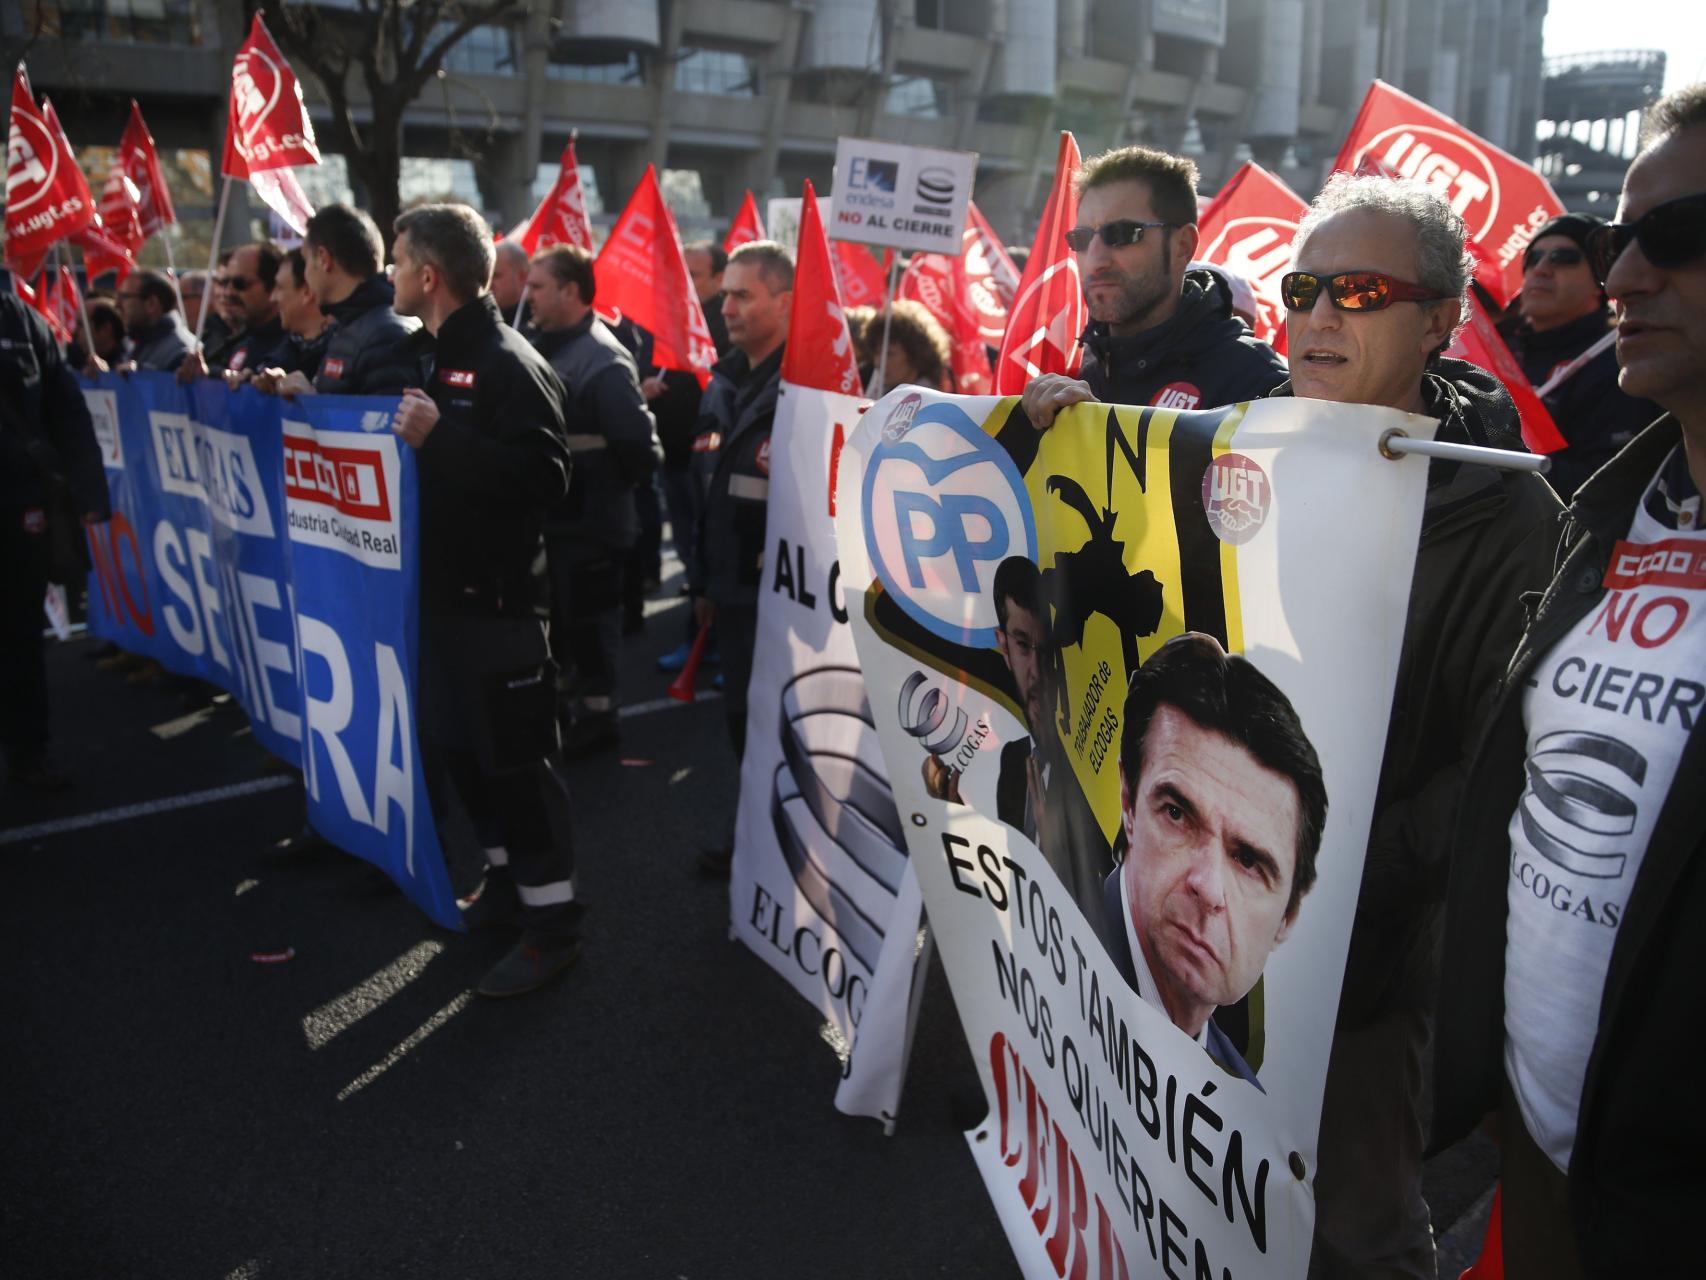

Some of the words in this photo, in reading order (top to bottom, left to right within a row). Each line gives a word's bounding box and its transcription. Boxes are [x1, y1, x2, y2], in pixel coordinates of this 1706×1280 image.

[1383, 132, 1490, 218] UGT
[838, 211, 862, 225] NO
[866, 214, 888, 229] AL
[893, 218, 955, 238] CIERRE
[1155, 387, 1200, 410] UGT
[1209, 464, 1264, 508] UGT
[361, 530, 398, 555] Real
[773, 538, 816, 610] AL
[893, 490, 1010, 594] PP
[154, 518, 231, 673] SE
[1587, 591, 1690, 649] NO
[1074, 673, 1104, 760] TRABAJADOR
[1097, 660, 1112, 684] de
[1552, 656, 1706, 731] CIERR
[950, 719, 990, 776] LCOGAS
[1089, 706, 1119, 776] ELCOGAS
[992, 939, 1055, 1069] NOS
[941, 832, 1066, 986] ESTOS
[1071, 935, 1269, 1254] TAMBIÉN
